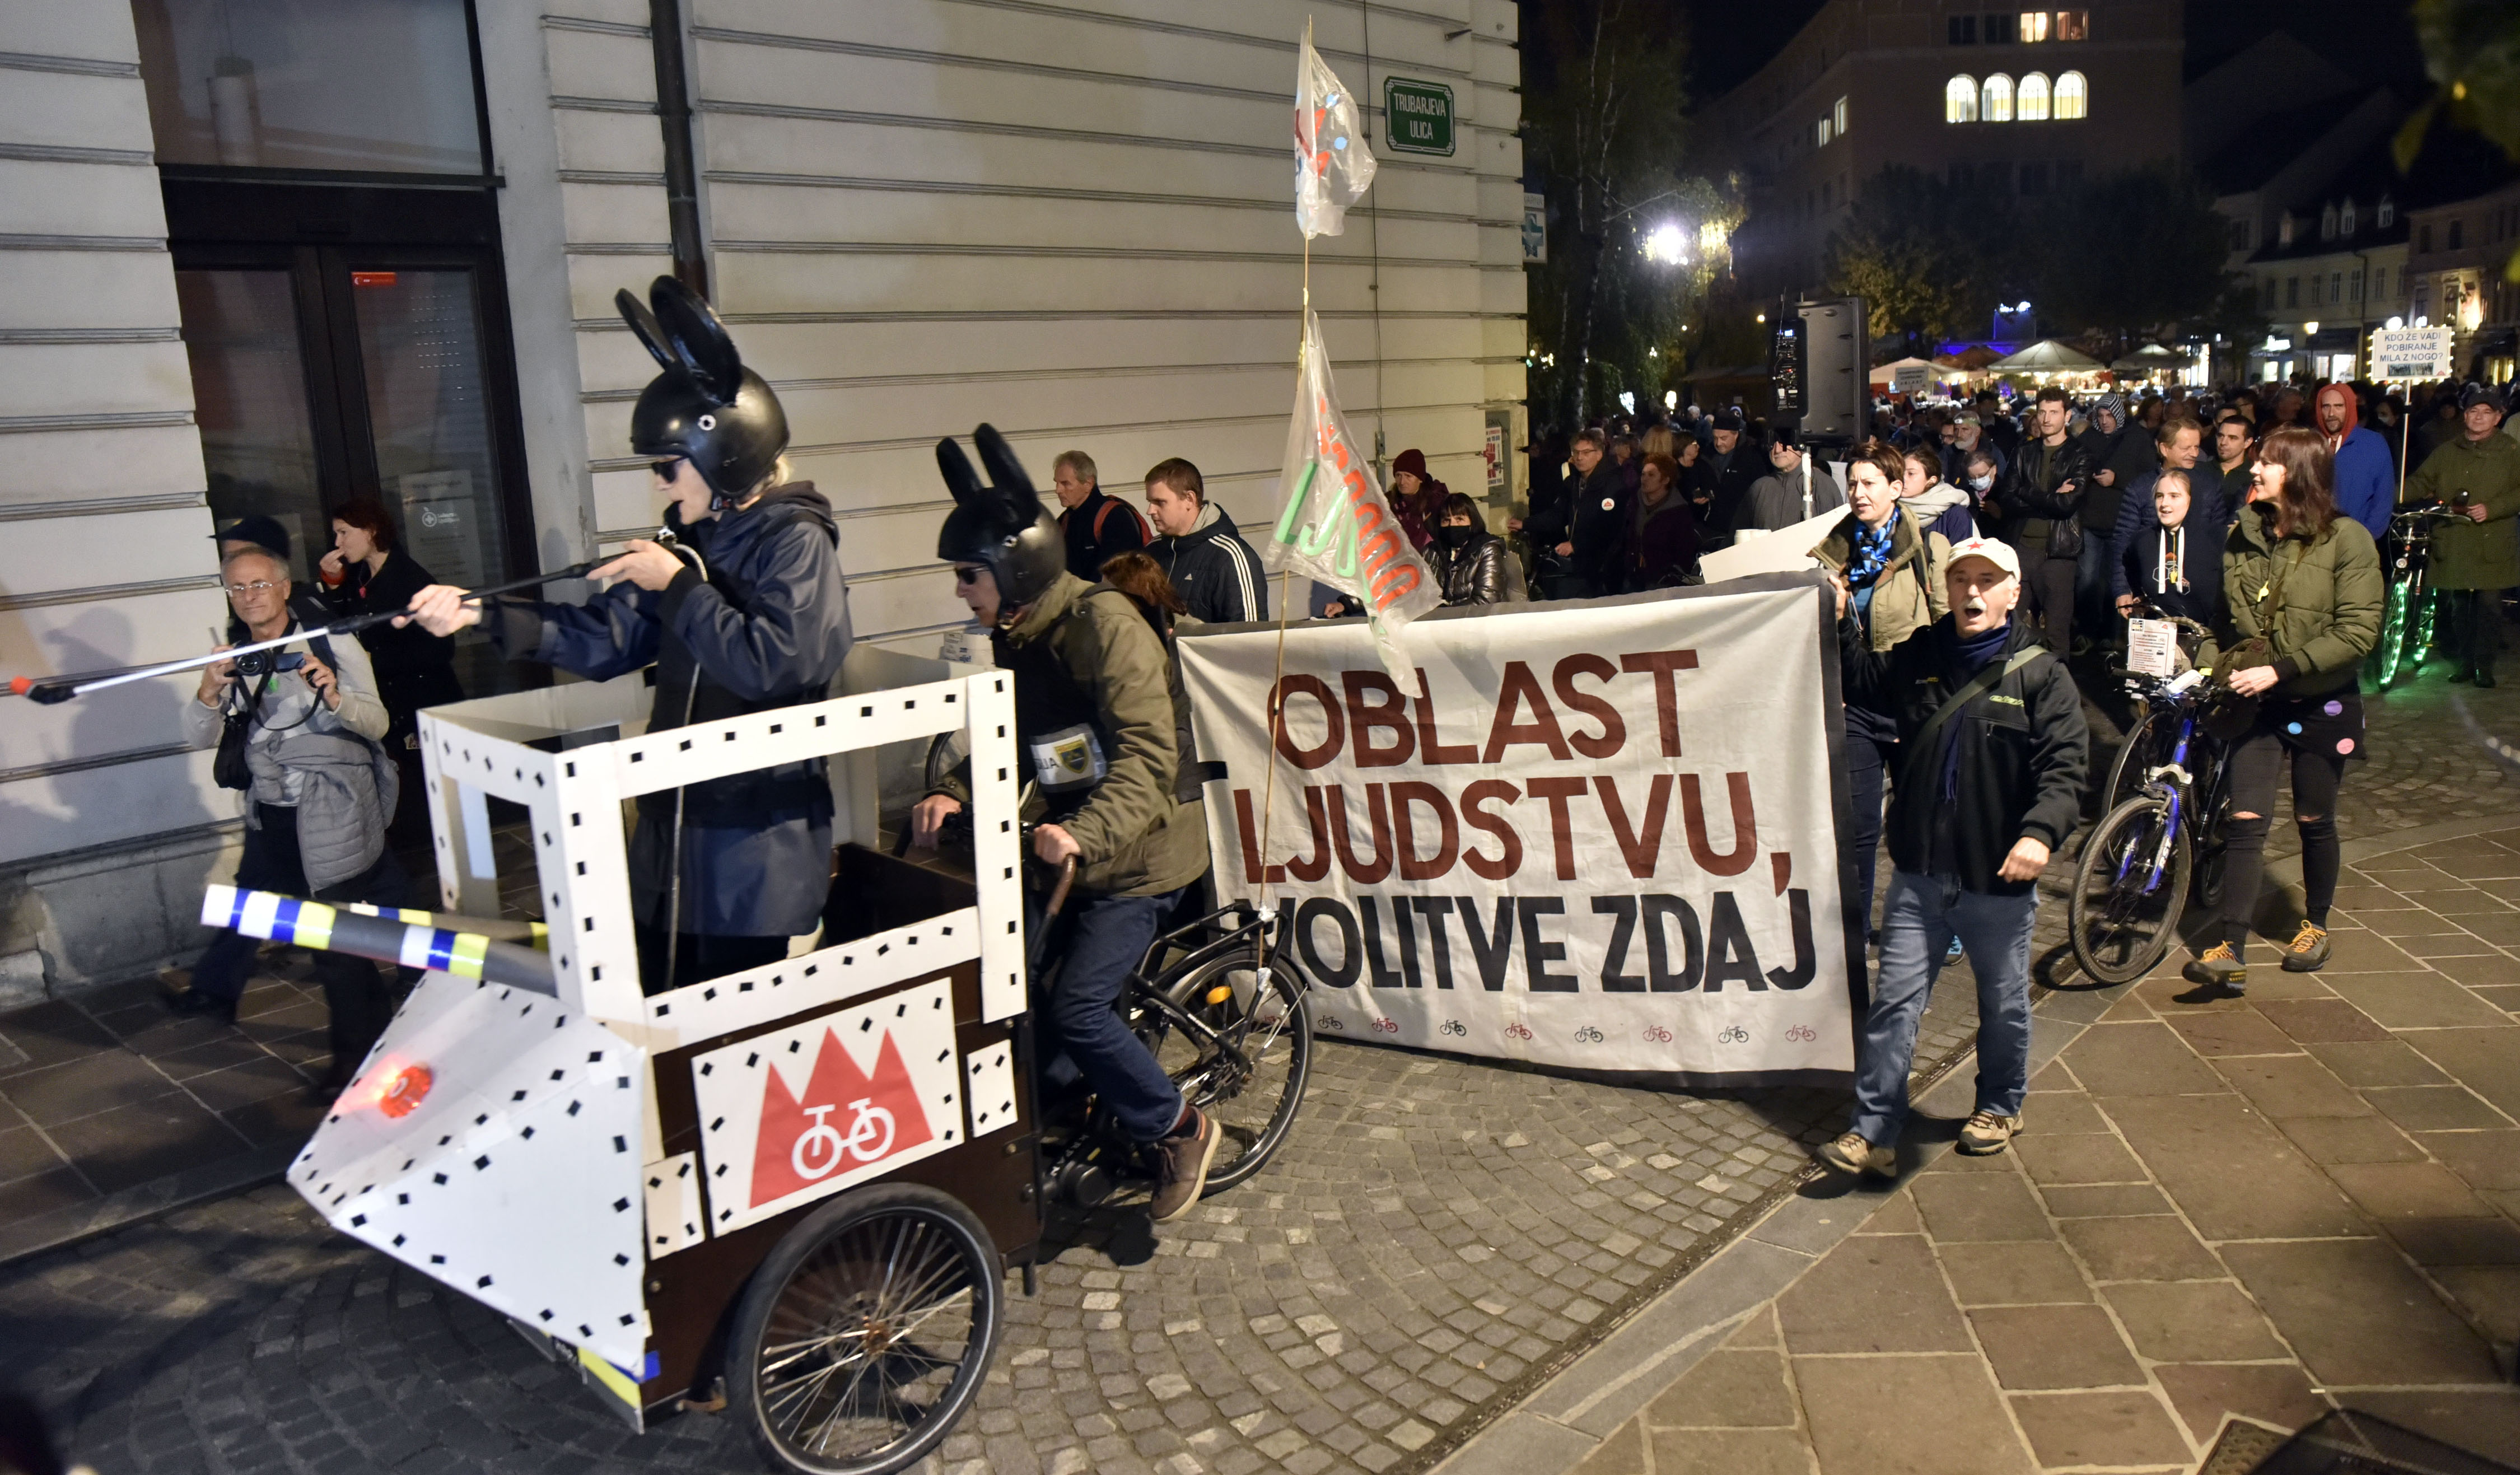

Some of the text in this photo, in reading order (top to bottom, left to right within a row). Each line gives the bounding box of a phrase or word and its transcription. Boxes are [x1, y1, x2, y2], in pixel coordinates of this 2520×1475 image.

[1393, 93, 1446, 116] TRUBARJEVA
[1410, 120, 1433, 140] ULICA
[2386, 342, 2437, 351] POBIRANJE
[2406, 332, 2417, 340] ŽE
[2411, 352, 2443, 361] NOGO?
[1268, 648, 1699, 770] OBLAST
[1233, 771, 1792, 897] LJUDSTVU,
[1592, 888, 1816, 993] ZDAJ
